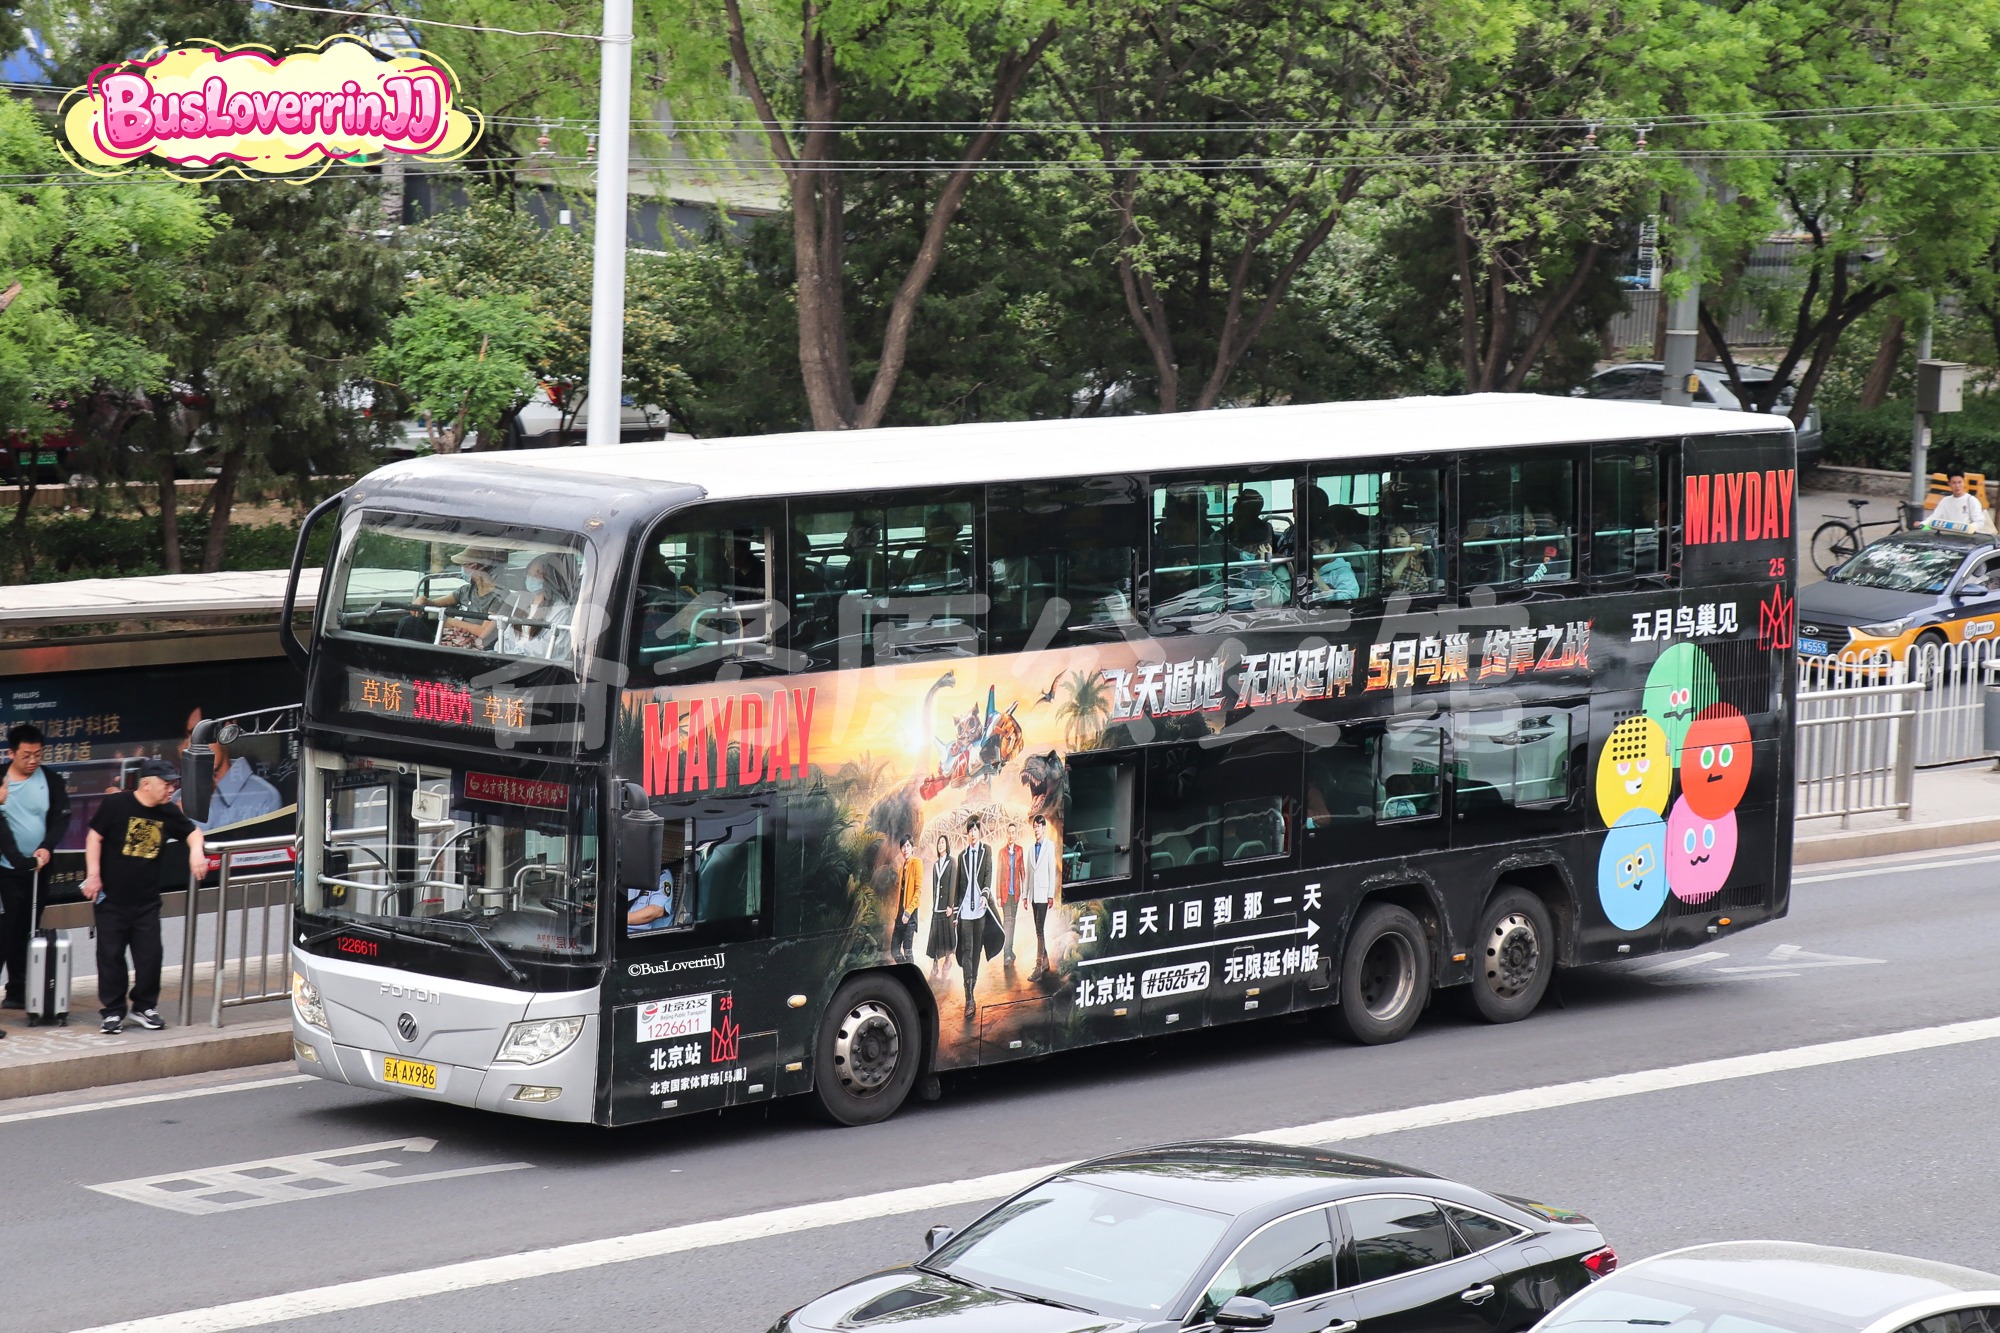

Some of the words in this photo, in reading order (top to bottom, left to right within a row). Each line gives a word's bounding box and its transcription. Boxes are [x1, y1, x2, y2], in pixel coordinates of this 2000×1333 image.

[1685, 469, 1795, 546] MAYDAY
[1769, 557, 1786, 577] 25
[1631, 601, 1739, 643] 五月鸟巢见
[1101, 656, 1227, 724] 飞天遁地
[1235, 644, 1356, 709] 无限延伸
[1364, 632, 1470, 691] 5月鸟巢
[1477, 619, 1593, 678] 终章之战
[361, 679, 403, 712] 草桥
[483, 695, 526, 729] 草桥
[643, 687, 817, 797] MAYDAY
[337, 937, 378, 957] 1226611
[1224, 944, 1320, 985] 无限延伸版
[379, 983, 441, 1005] FOTON
[1075, 972, 1135, 1008] 北京站
[1146, 965, 1207, 995] #5525+2
[660, 1013, 674, 1021] Beijing
[674, 1011, 687, 1019] Public
[662, 998, 708, 1014] 北京公交
[719, 997, 733, 1011] 25
[648, 1018, 700, 1039] 1226611
[650, 1042, 702, 1071] 北京站
